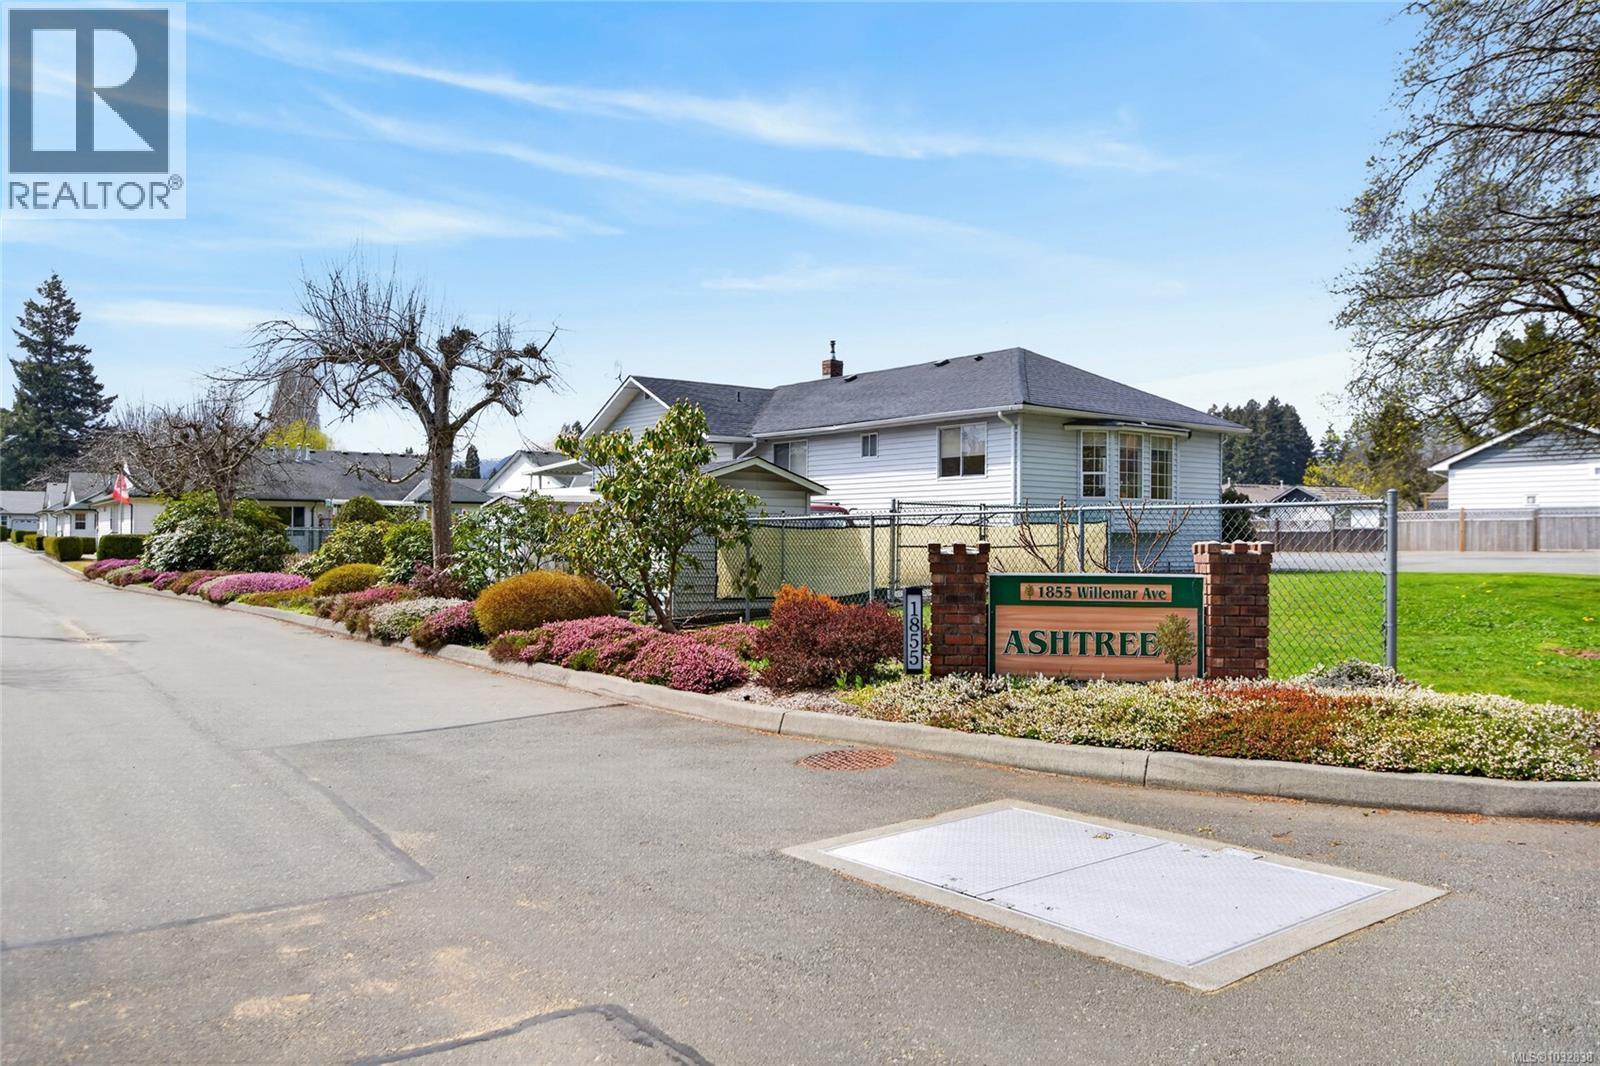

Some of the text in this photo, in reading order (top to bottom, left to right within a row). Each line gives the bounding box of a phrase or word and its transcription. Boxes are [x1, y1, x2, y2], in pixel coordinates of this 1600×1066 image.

[1038, 586, 1167, 600] 1855 Willemar Ave
[909, 601, 920, 666] 1855
[1003, 629, 1162, 658] ASHTREE
